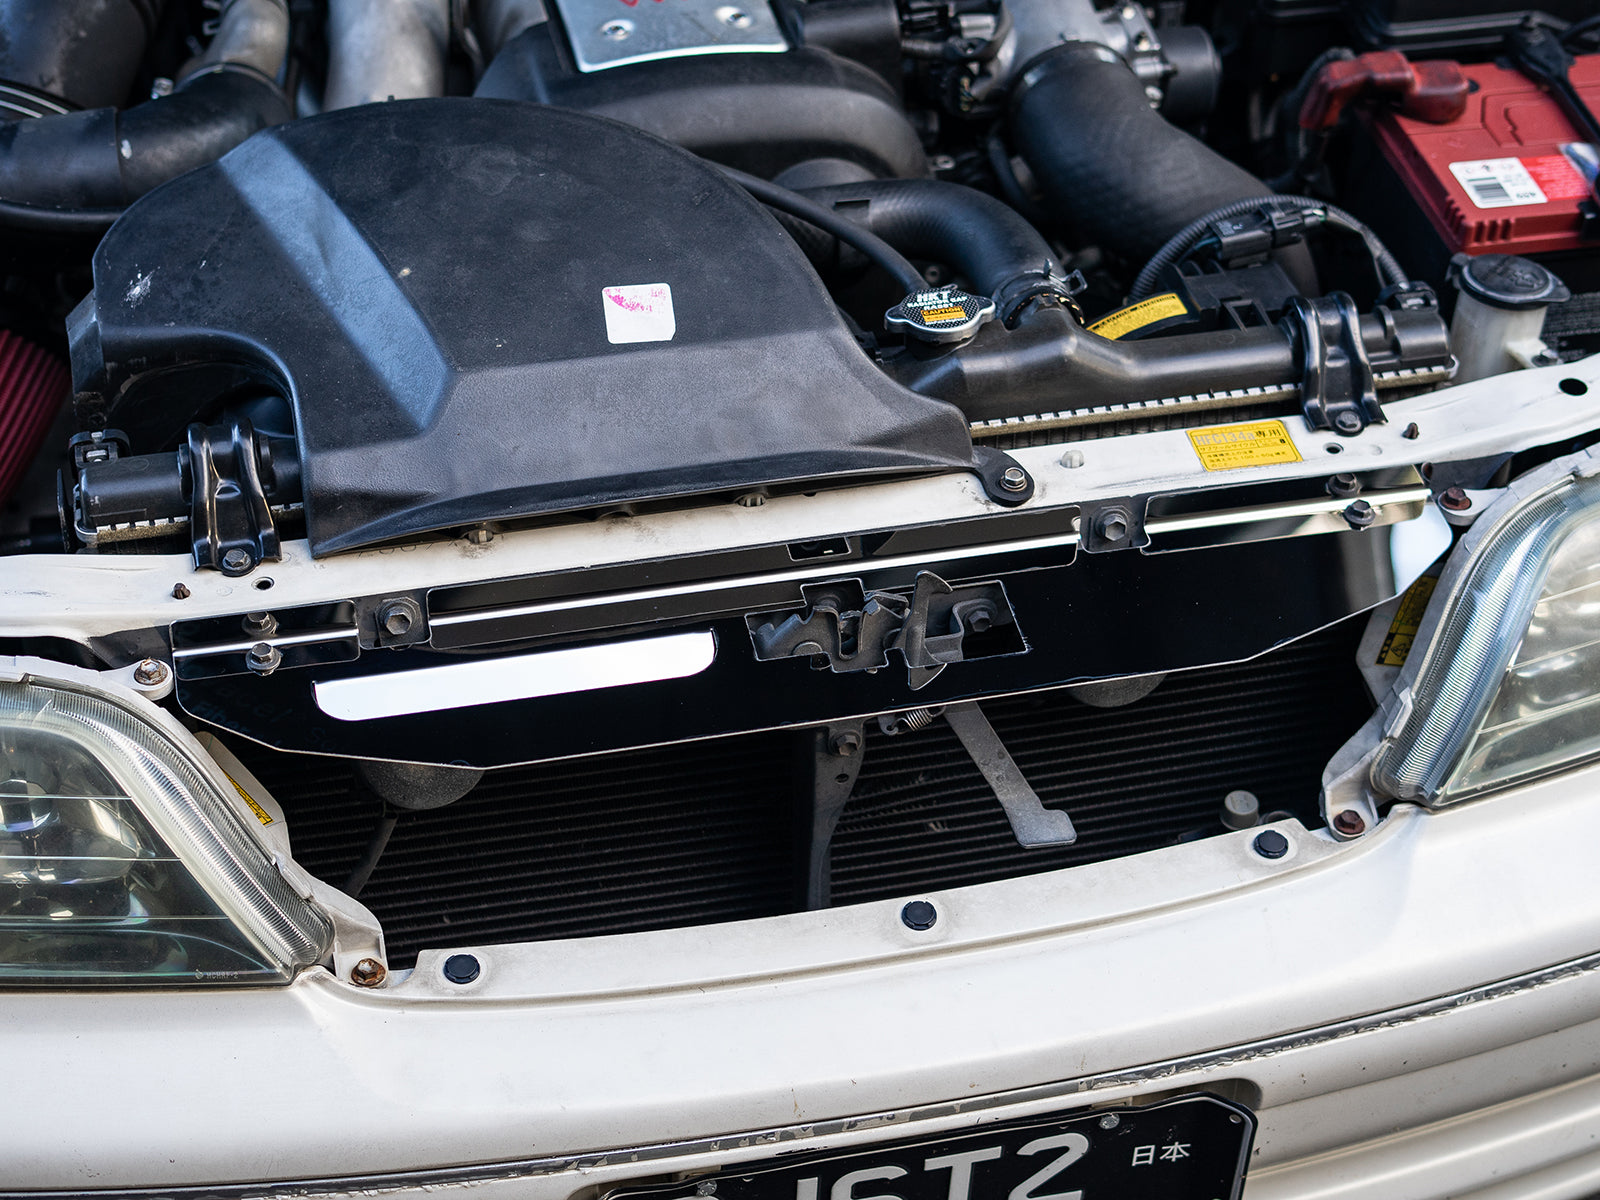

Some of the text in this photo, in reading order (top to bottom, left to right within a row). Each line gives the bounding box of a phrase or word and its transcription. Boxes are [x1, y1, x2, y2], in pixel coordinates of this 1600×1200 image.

[917, 290, 951, 302] HKT
[924, 307, 961, 315] CAUTION
[1131, 1141, 1192, 1167] 日本
